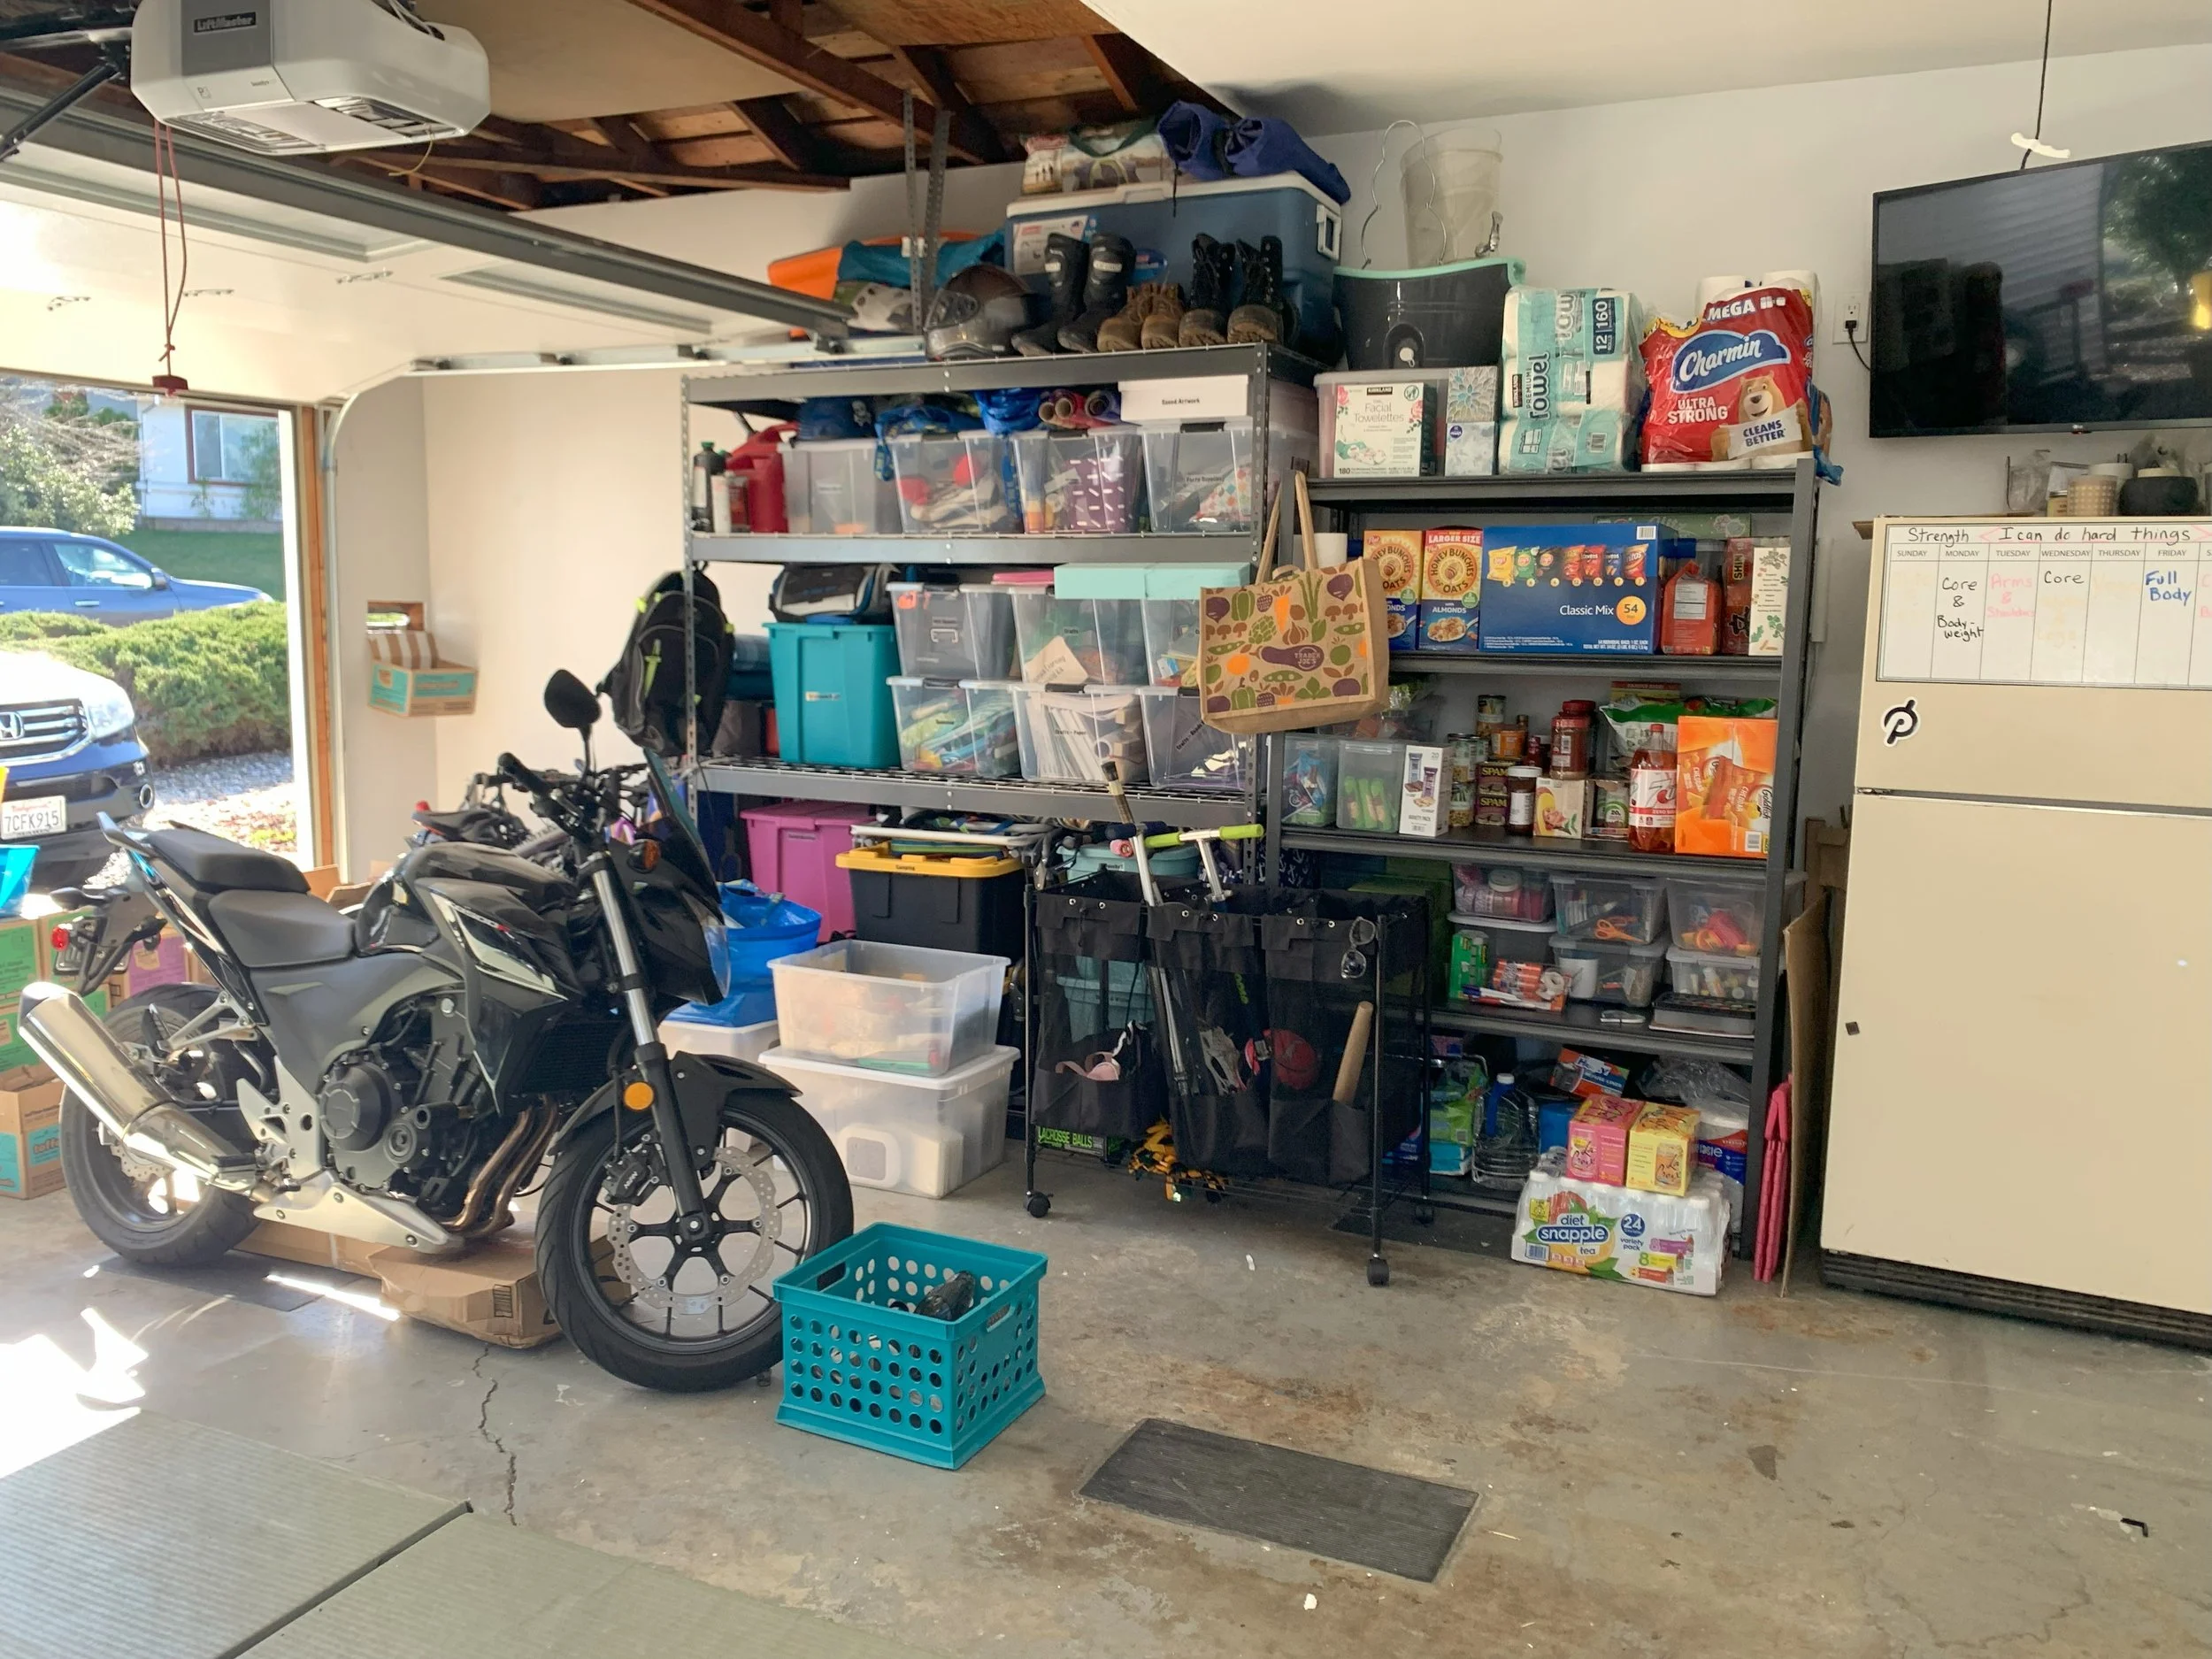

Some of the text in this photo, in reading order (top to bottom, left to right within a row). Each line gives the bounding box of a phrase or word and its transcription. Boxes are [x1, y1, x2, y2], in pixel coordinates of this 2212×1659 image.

[1595, 301, 1609, 328] 160
[1707, 299, 1756, 321] MEGA
[1595, 334, 1608, 351] 12
[1679, 335, 1763, 382] Charmin
[1364, 403, 1393, 413] Facial
[1678, 396, 1716, 410] ULTRA
[1354, 413, 1404, 423] Towelettes
[1668, 406, 1728, 424] STRONG
[1743, 420, 1783, 438] CLEANS
[1745, 429, 1785, 447] BETTER
[1428, 534, 1481, 544] LARGER SIZE
[1909, 527, 1970, 548] Strength
[1999, 526, 2014, 541] I
[2017, 531, 2043, 541] can
[2082, 527, 2116, 541] hard
[2131, 526, 2191, 546] things
[1430, 549, 1474, 577] HONEY BUNCHES
[1734, 554, 1743, 579] SHIN
[1382, 577, 1406, 589] OATS
[1942, 577, 1978, 591] Core
[1991, 573, 2032, 589] Arms
[2044, 571, 2085, 584] Core
[2145, 571, 2177, 586] Full
[1443, 580, 1469, 593] OATS
[1953, 595, 1964, 608] &
[2150, 587, 2192, 606] Body
[1559, 604, 1614, 616] Classic Mix
[1624, 603, 1639, 614] 54
[1944, 626, 1984, 641] weight
[1480, 797, 1508, 807] SPAM
[4, 810, 59, 833] 7CFK915
[1038, 1125, 1094, 1149] LACROSSE BALLS
[1560, 1214, 1585, 1225] diet
[1623, 1216, 1642, 1231] 24
[1540, 1225, 1606, 1244] snapple
[1620, 1237, 1644, 1247] variety
[1580, 1246, 1596, 1255] tea
[1639, 1252, 1649, 1266] 8
